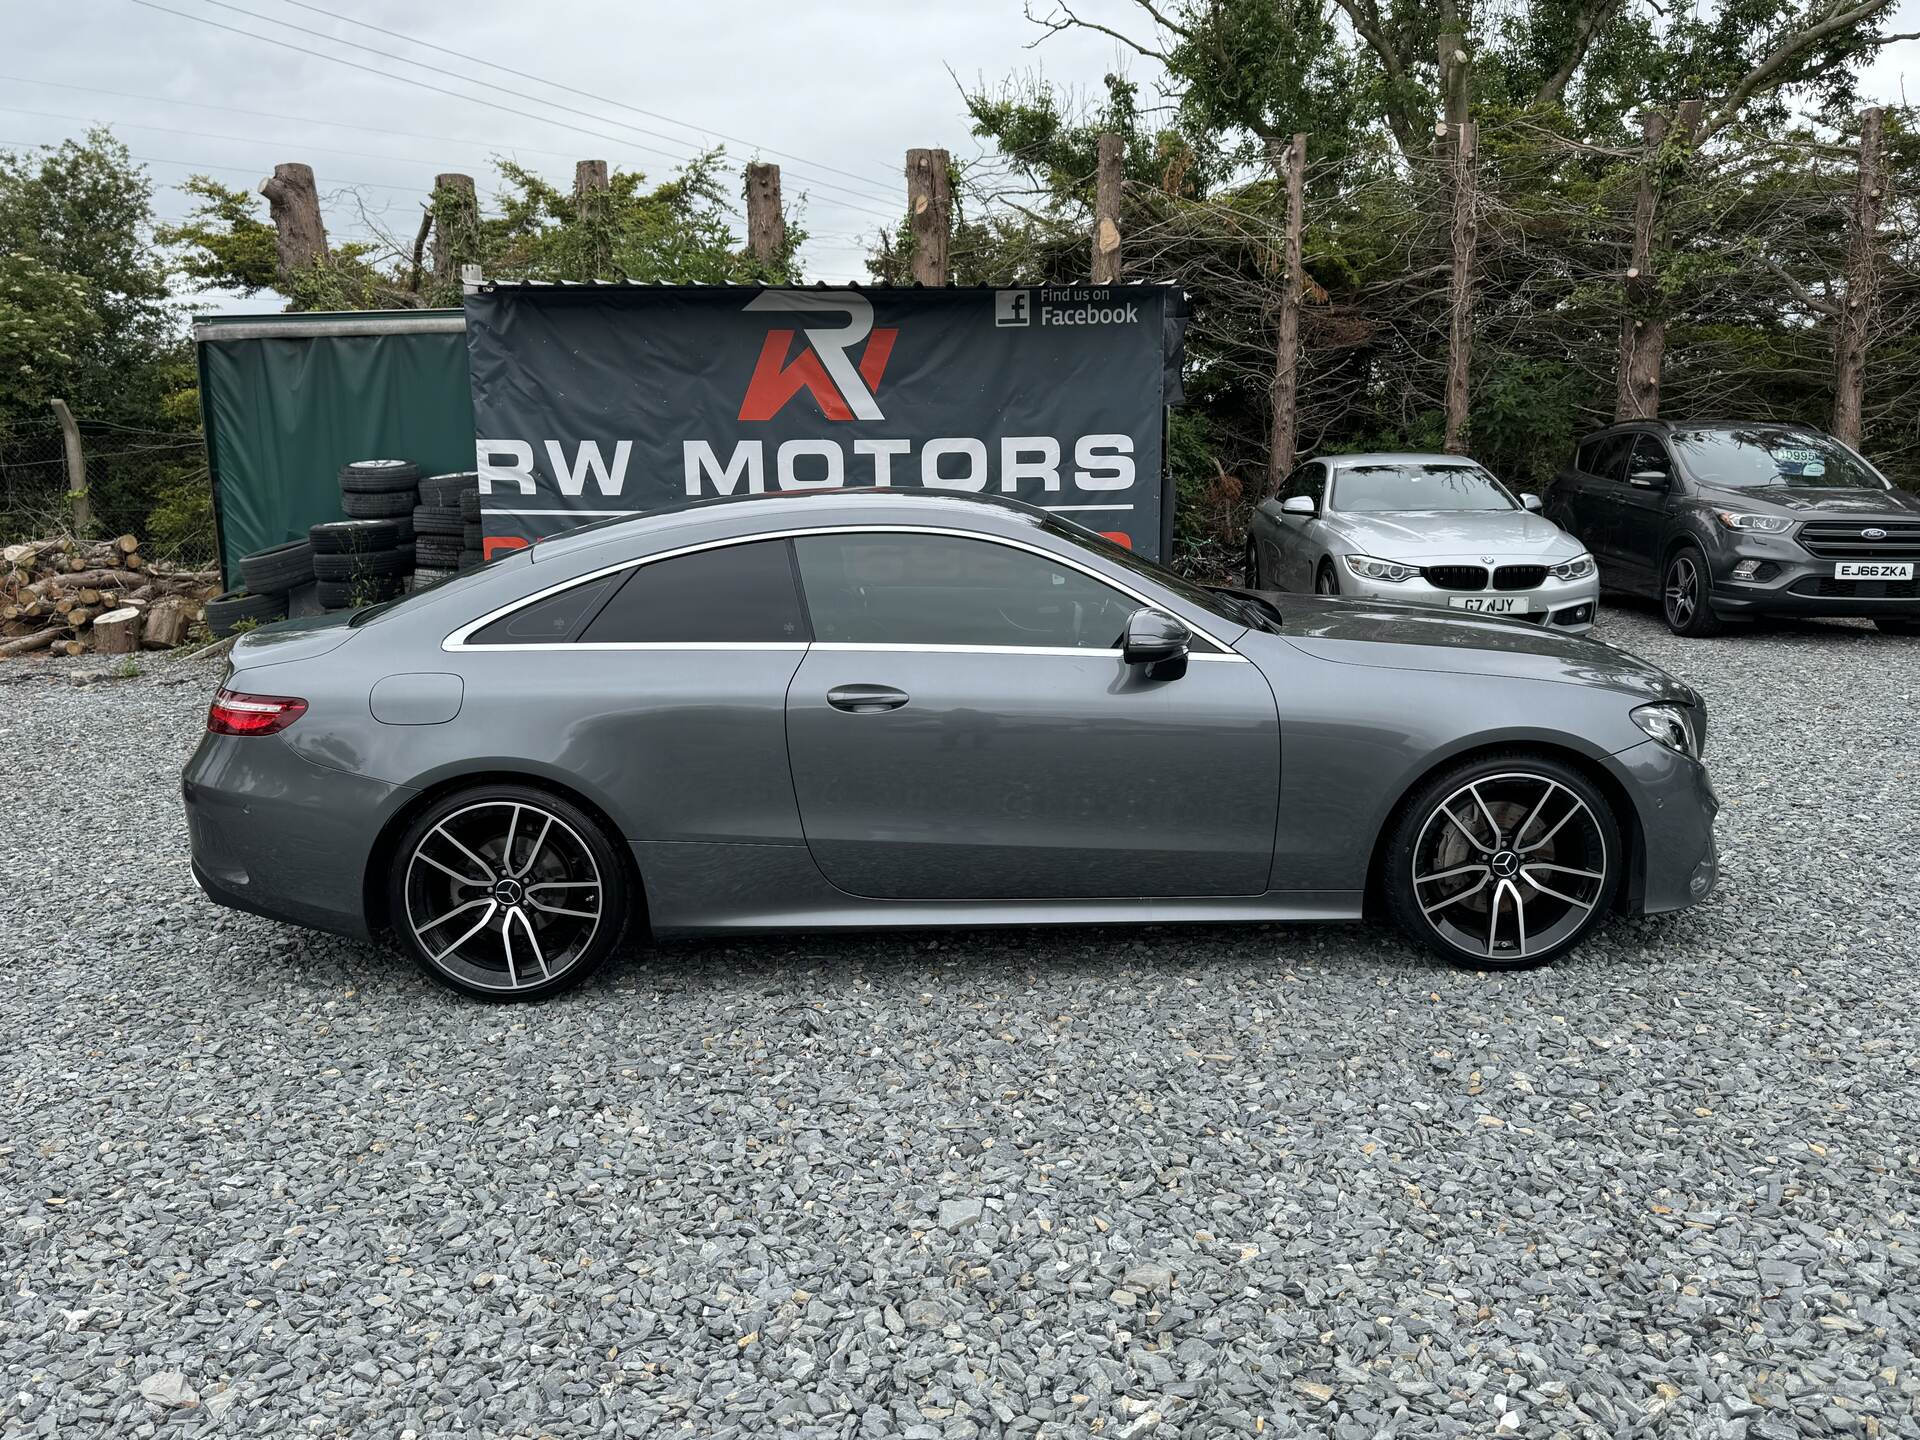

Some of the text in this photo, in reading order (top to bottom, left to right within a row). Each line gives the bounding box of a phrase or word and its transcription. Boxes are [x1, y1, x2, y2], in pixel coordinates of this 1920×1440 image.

[1040, 289, 1110, 302] Find us on
[1041, 303, 1138, 326] Facebook
[476, 434, 1136, 496] RW MOTORS
